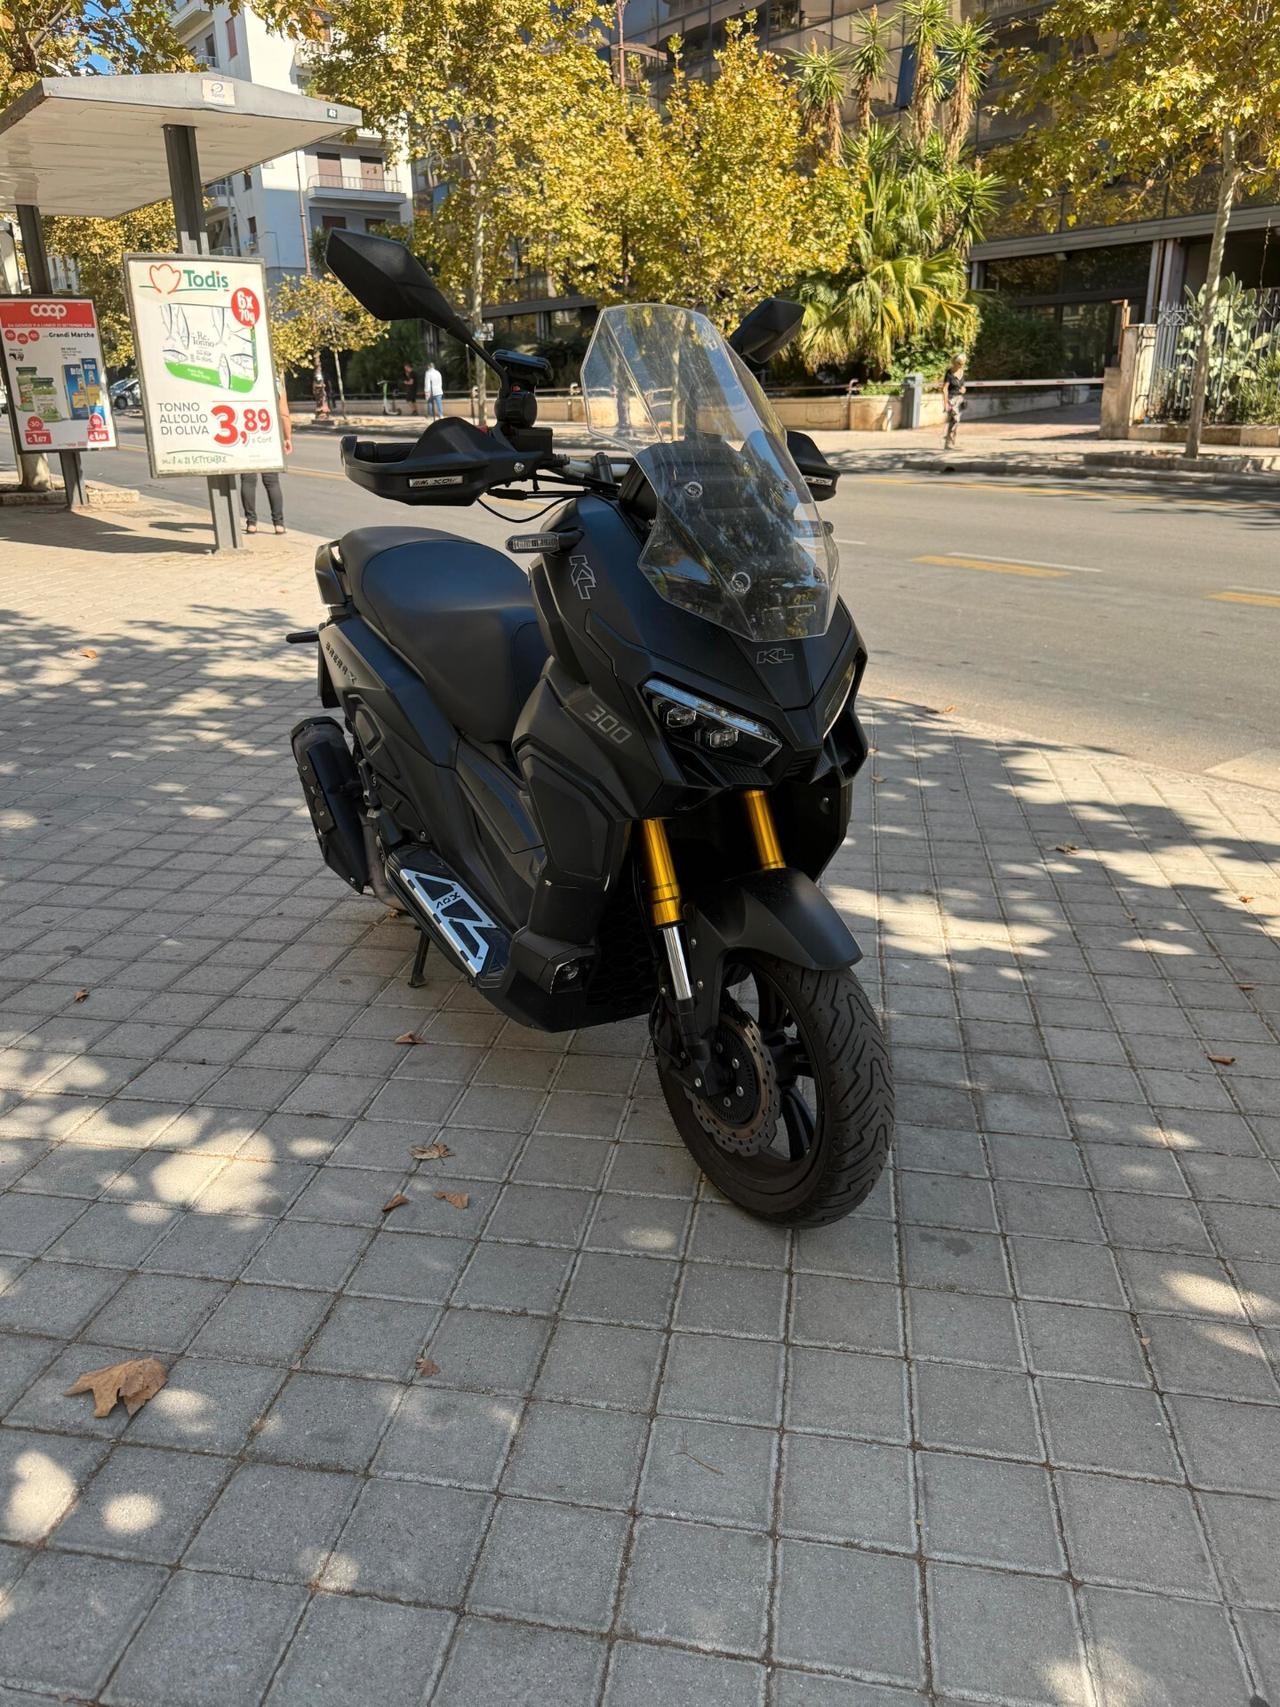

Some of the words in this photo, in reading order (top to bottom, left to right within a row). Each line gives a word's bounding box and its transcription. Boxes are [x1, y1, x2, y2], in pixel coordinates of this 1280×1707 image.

[183, 269, 229, 288] Todis
[237, 290, 254, 310] 6x
[30, 304, 67, 320] coop
[157, 402, 200, 412] TONNO
[159, 413, 208, 424] ALL'OLIO
[211, 404, 271, 445] 3,89
[161, 426, 172, 435] DI
[175, 425, 209, 435] OLIVA
[568, 554, 597, 600] KL
[756, 648, 794, 664] KL
[584, 704, 633, 744] 300
[436, 891, 461, 909] XDV
